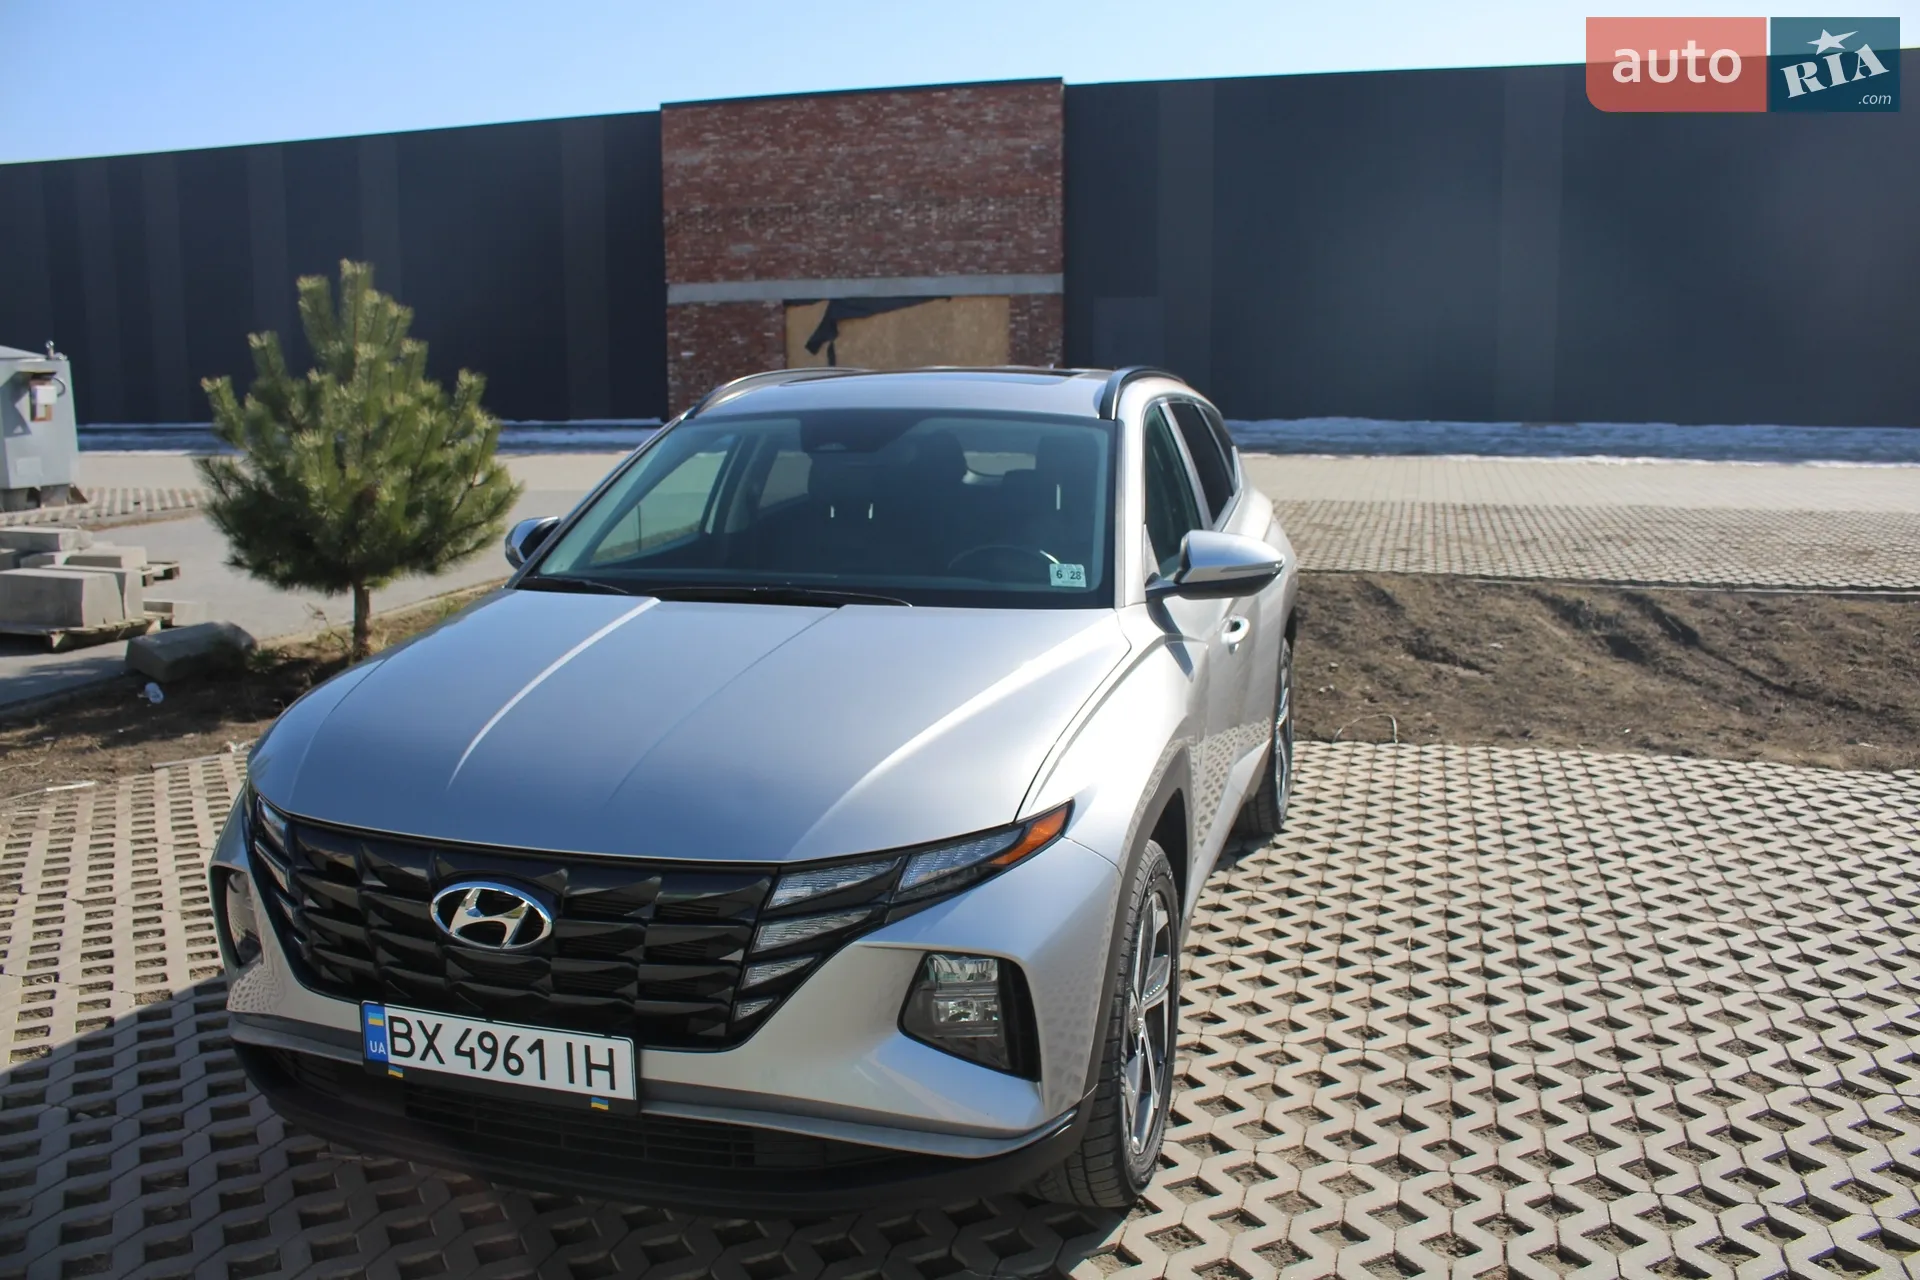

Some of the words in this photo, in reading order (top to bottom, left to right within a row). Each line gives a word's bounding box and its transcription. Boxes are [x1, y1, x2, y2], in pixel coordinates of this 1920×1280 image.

[1070, 571, 1082, 580] 28
[369, 1040, 387, 1055] UA
[388, 1015, 445, 1065] BX
[454, 1028, 546, 1081] 4961
[566, 1042, 616, 1090] IH
